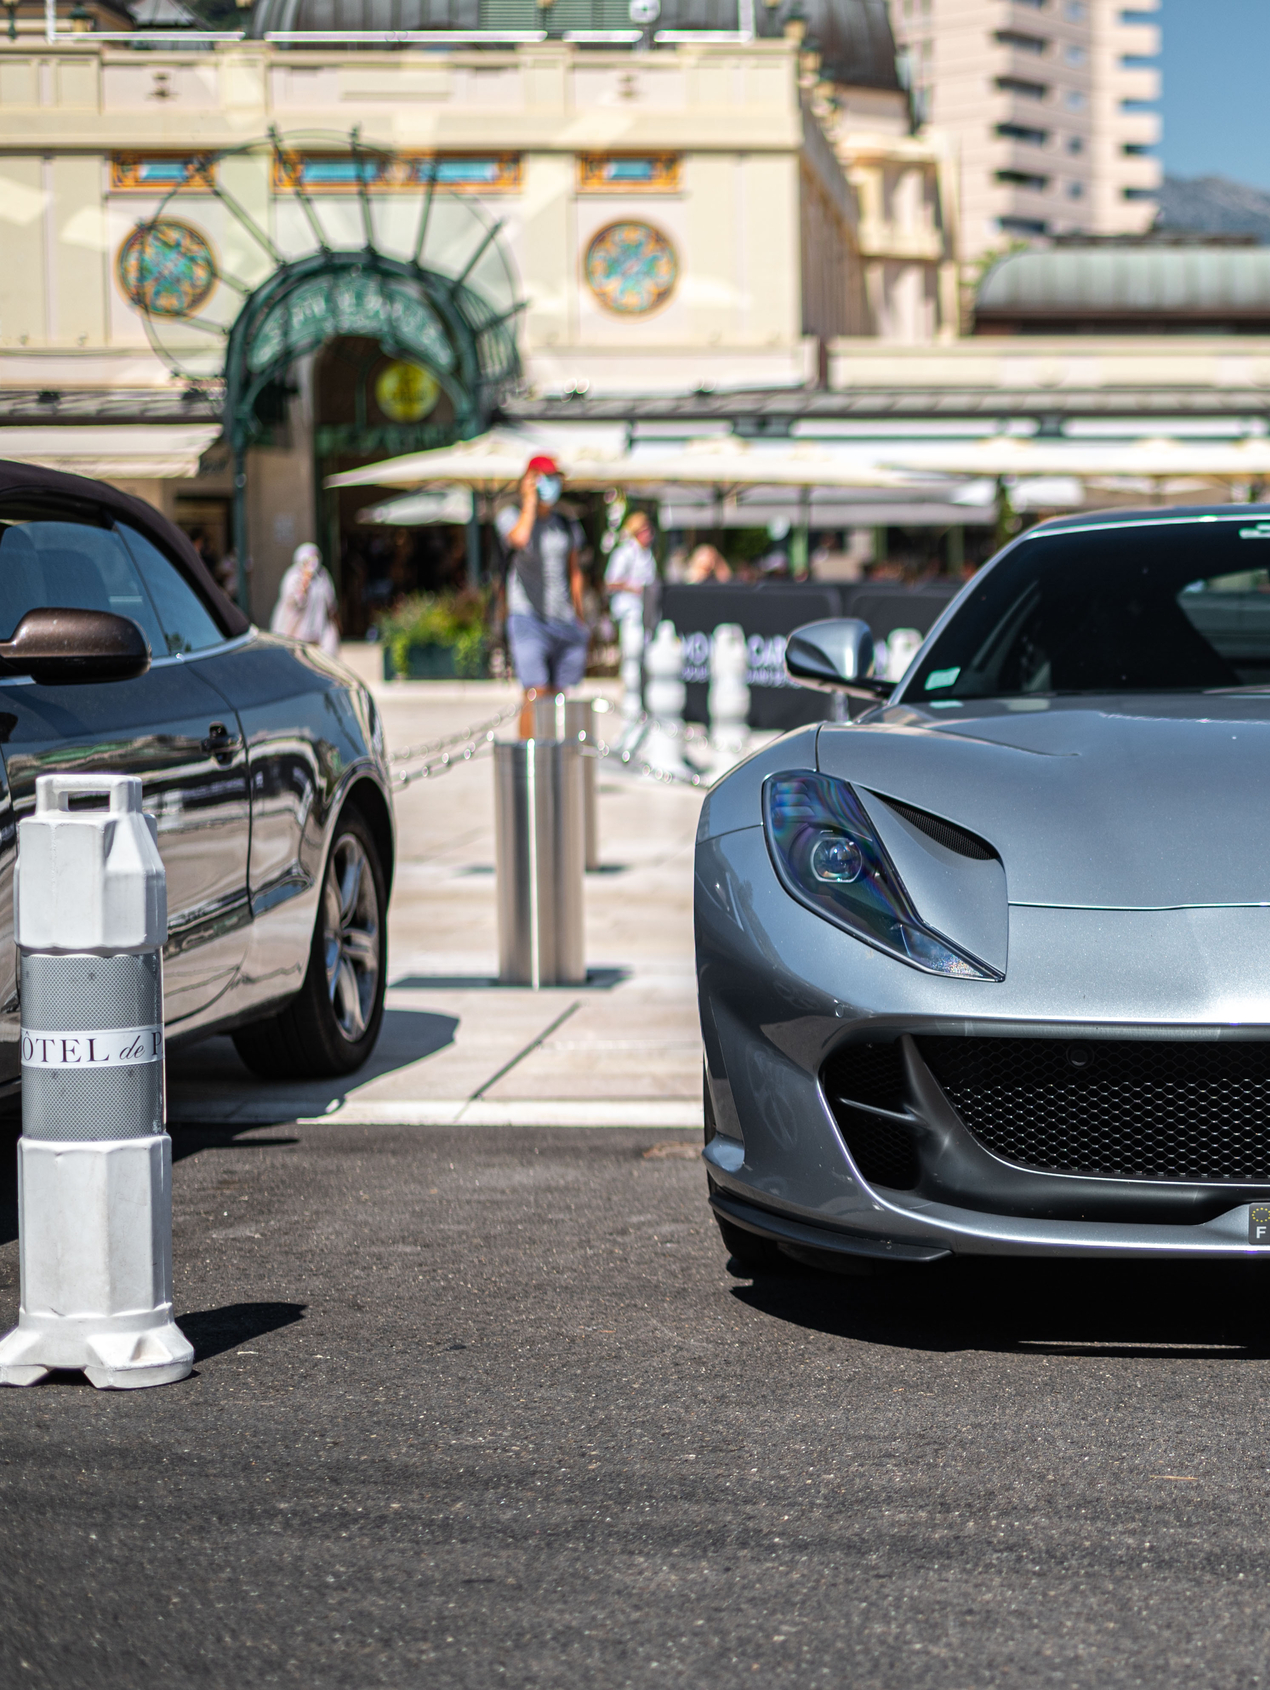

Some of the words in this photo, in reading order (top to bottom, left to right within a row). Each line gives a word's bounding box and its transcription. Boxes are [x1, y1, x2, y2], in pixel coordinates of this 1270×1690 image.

[21, 1031, 109, 1063] ÔTEL
[119, 1035, 146, 1060] de
[151, 1031, 164, 1056] P
[1256, 1226, 1267, 1239] F
